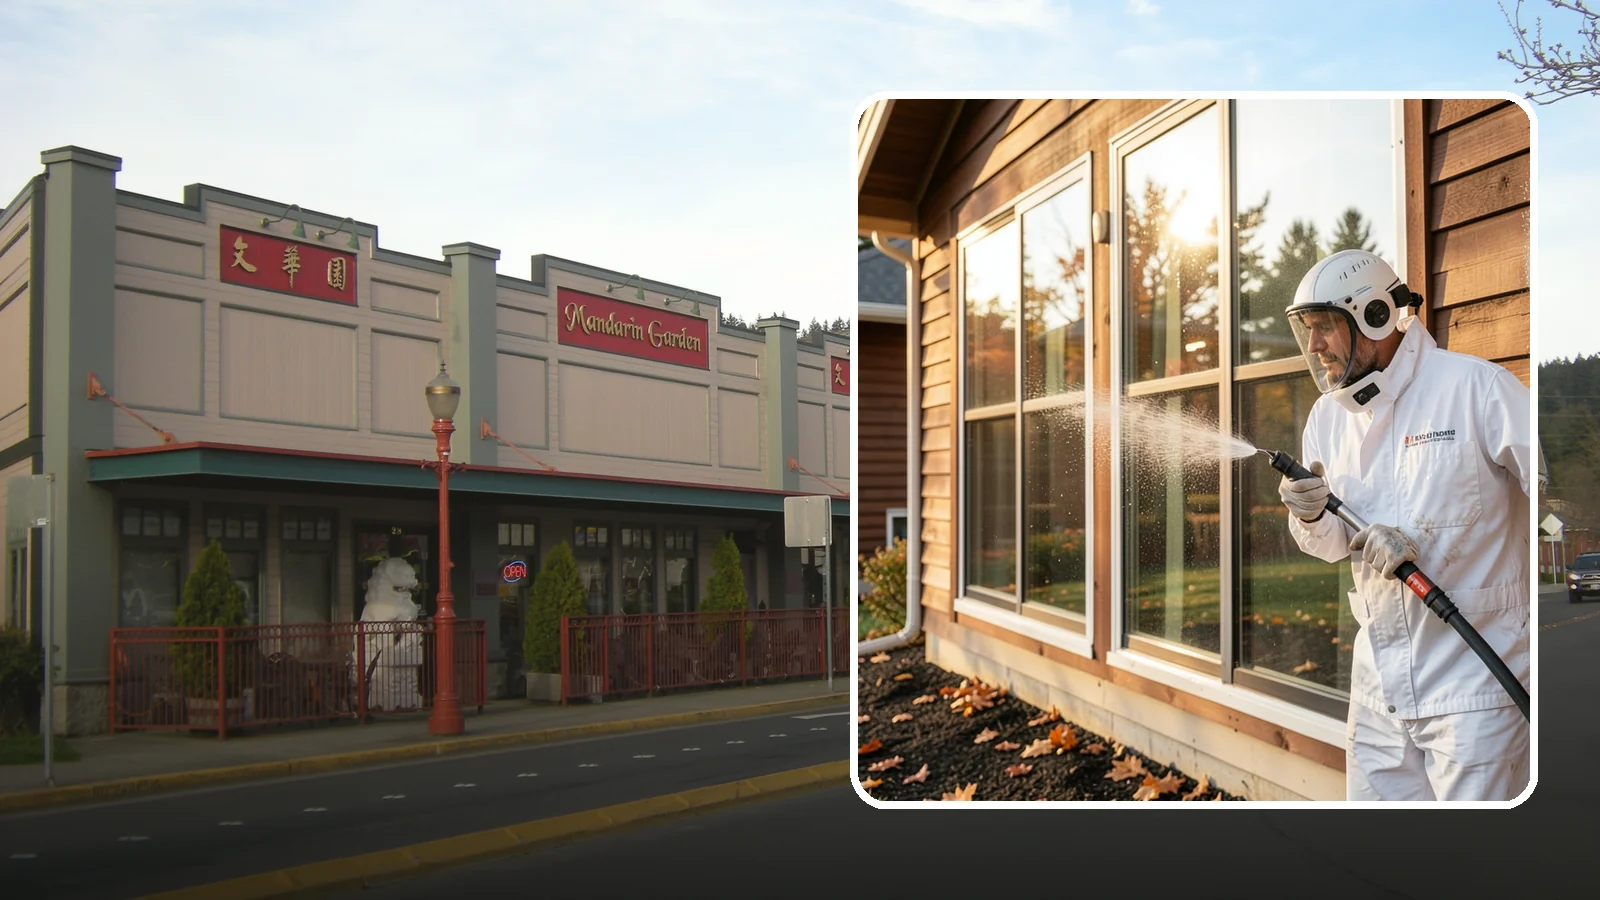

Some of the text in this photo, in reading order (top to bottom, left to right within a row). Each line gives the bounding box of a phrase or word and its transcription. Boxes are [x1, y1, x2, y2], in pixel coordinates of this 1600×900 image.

[230, 235, 347, 291] 文華園
[564, 301, 702, 352] Mandarin Garden
[503, 565, 527, 578] OPEN
